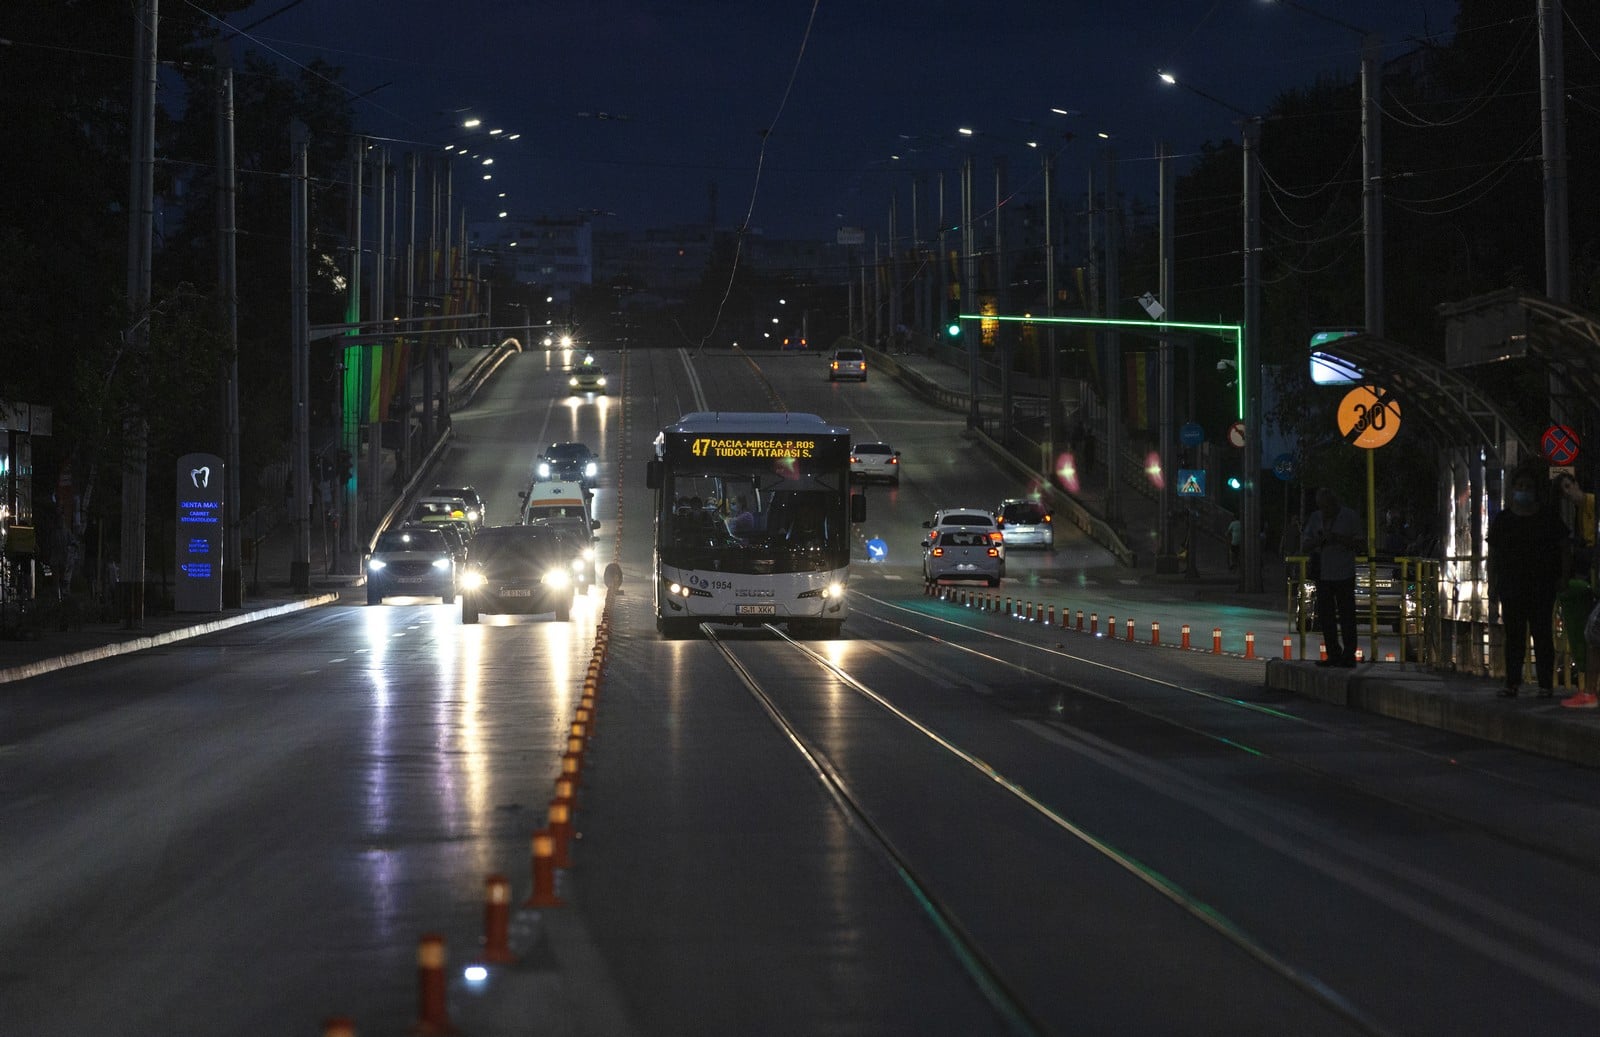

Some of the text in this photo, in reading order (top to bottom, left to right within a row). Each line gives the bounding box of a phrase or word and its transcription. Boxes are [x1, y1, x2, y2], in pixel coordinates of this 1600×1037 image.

[1354, 403, 1386, 430] 30
[692, 439, 711, 457] 47
[715, 448, 812, 458] TUDOR-TATARASI S.
[712, 581, 732, 589] 1954
[735, 589, 775, 597] ISUZU
